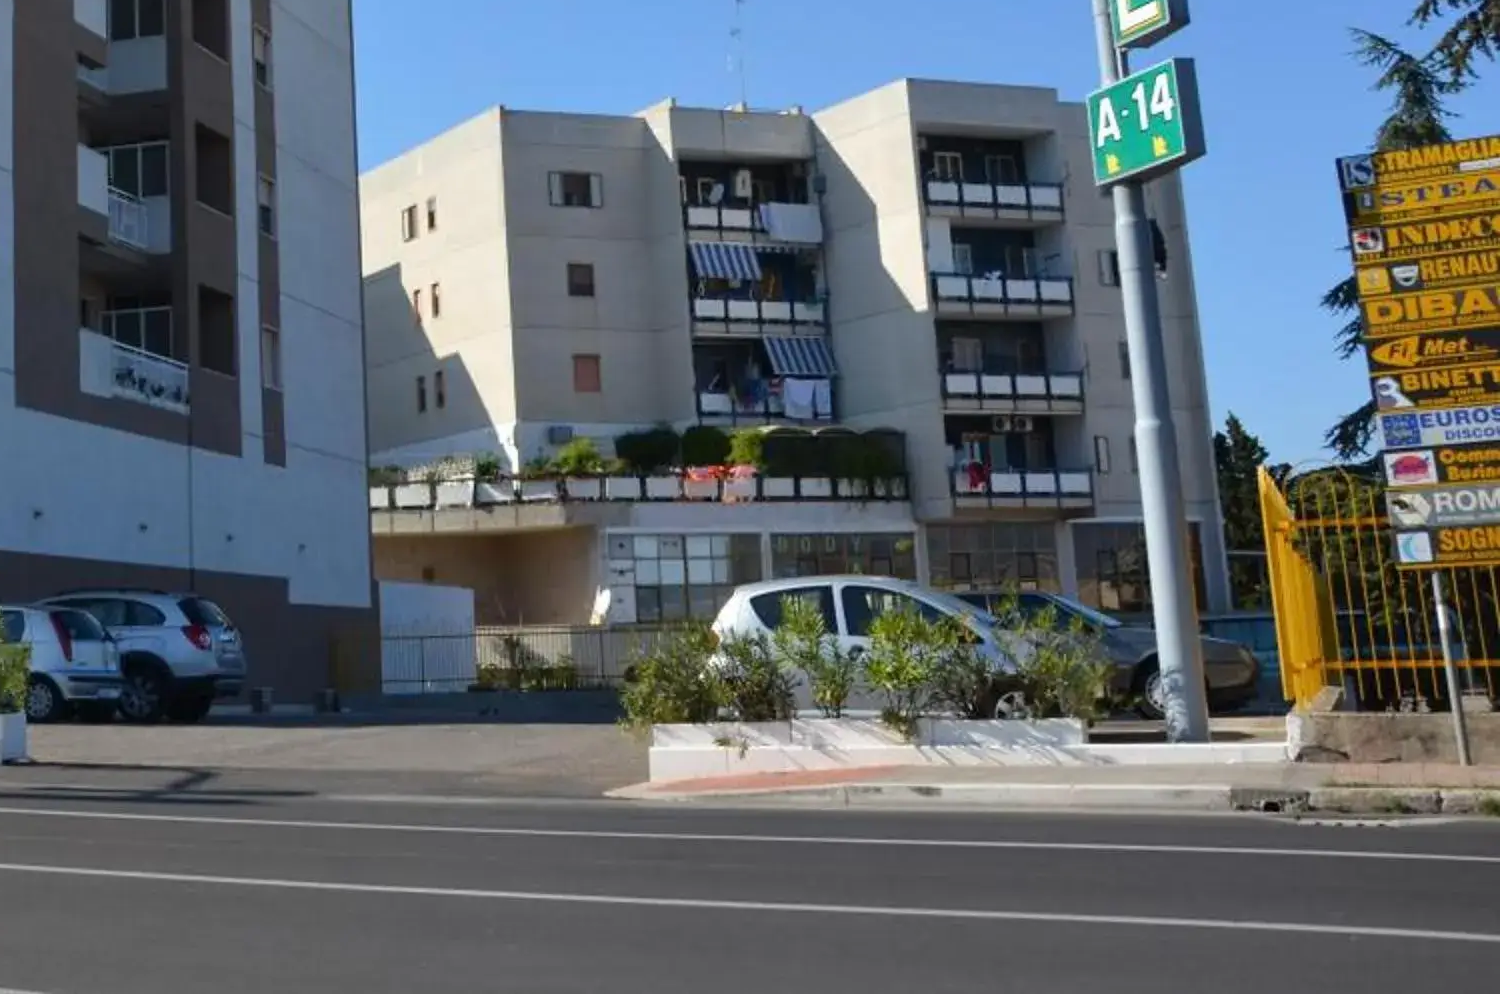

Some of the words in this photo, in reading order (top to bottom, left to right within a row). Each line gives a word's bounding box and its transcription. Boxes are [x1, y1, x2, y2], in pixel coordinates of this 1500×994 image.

[1421, 250, 1500, 281] RENAU
[1365, 286, 1500, 325] DIBA
[1445, 425, 1500, 440] DISCO
